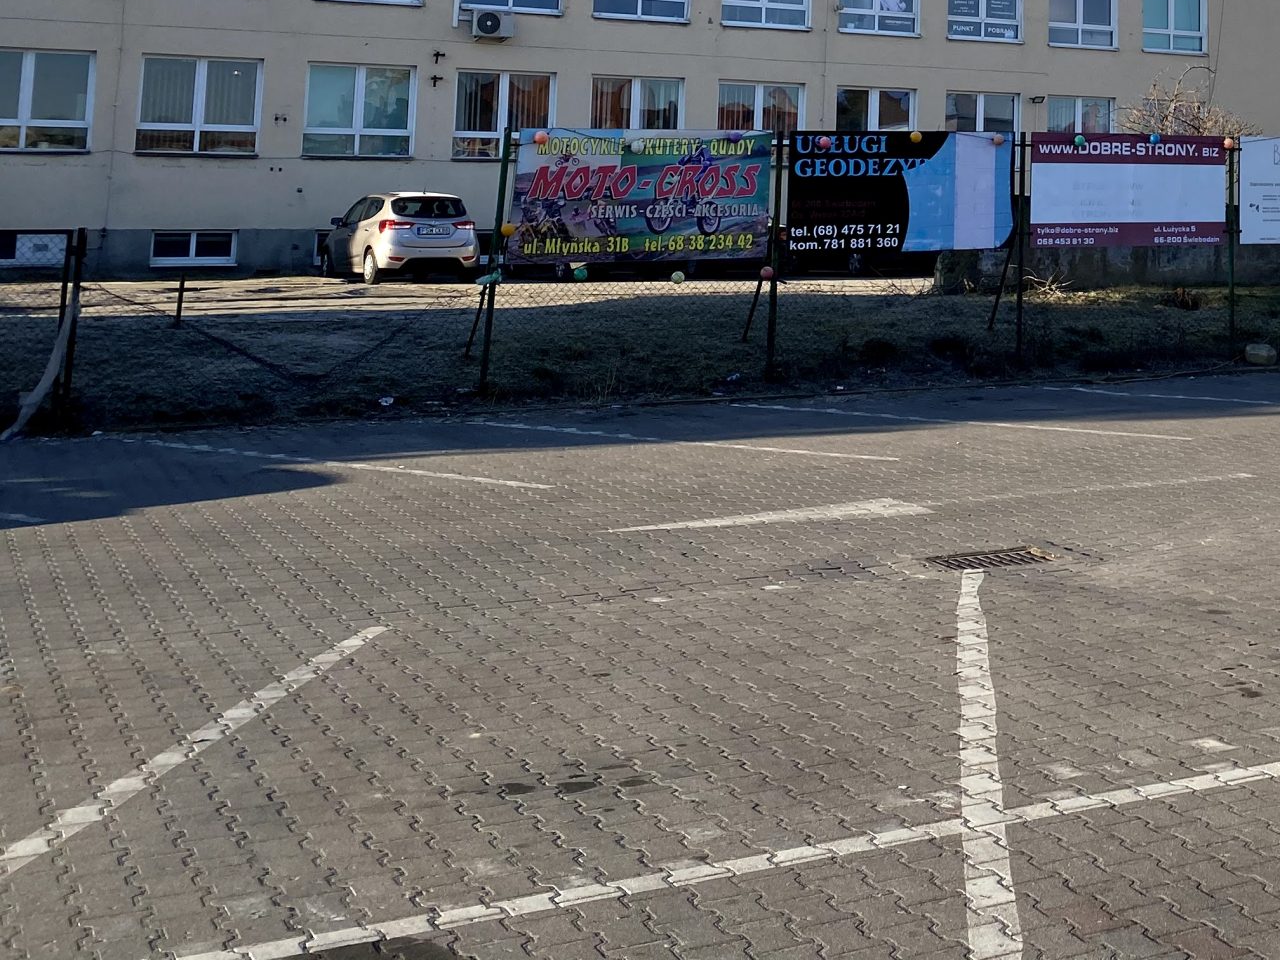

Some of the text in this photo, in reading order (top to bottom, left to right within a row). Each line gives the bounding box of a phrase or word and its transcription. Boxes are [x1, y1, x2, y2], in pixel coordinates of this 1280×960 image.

[953, 24, 974, 32] PUNKT
[538, 137, 626, 155] MOTOCYKLE
[638, 137, 700, 155] KUTERY
[710, 138, 756, 156] QUADY
[795, 135, 888, 154] USŁUGI
[527, 164, 762, 200] MOTO-CROSS
[791, 223, 900, 239] tel. (68) 475 71 21
[524, 234, 753, 255] ul. Młyńska 31B tel. 68 38 234 42
[789, 237, 899, 250] kom. 781 881 360
